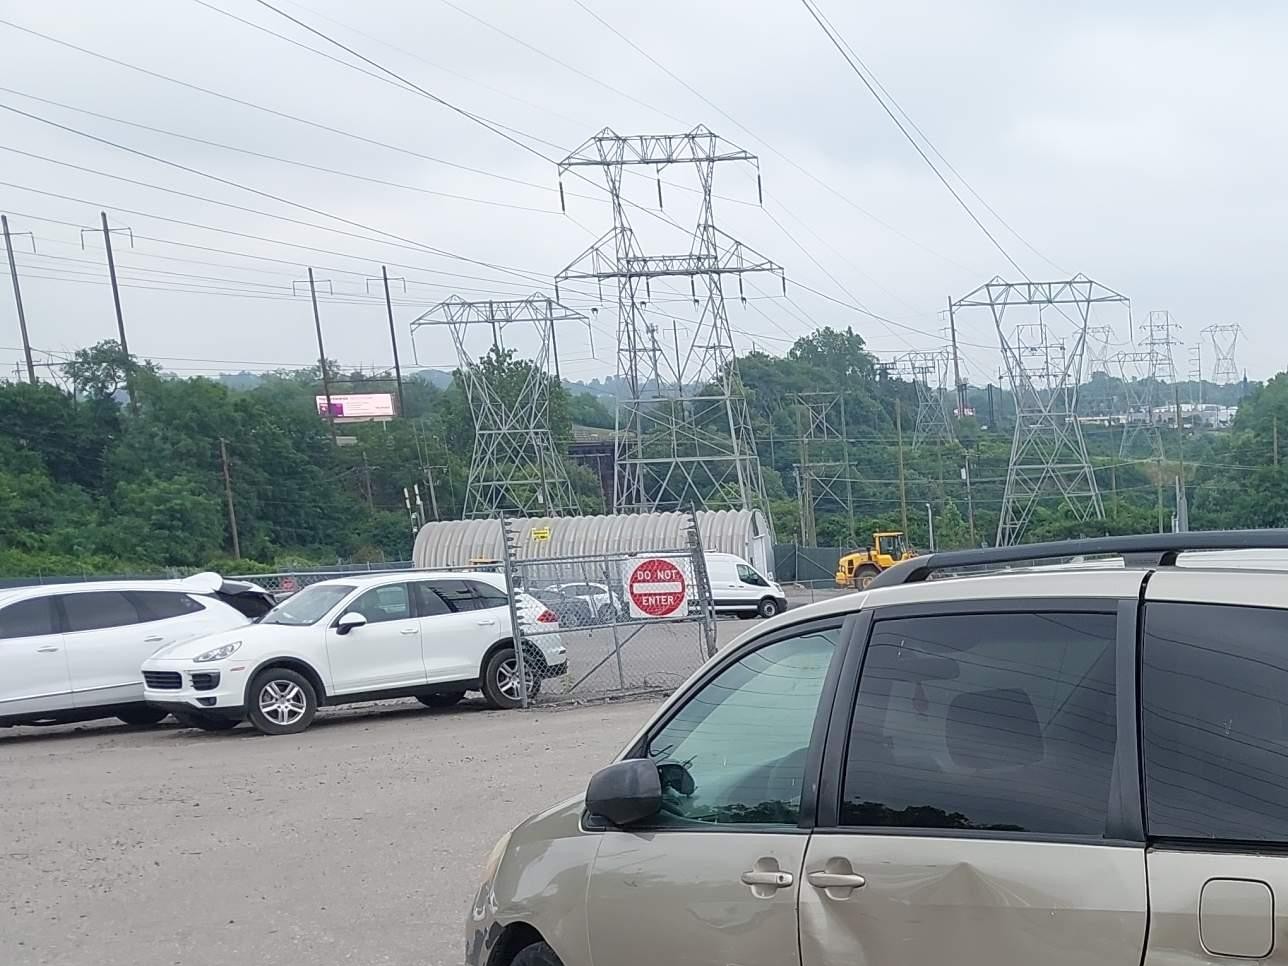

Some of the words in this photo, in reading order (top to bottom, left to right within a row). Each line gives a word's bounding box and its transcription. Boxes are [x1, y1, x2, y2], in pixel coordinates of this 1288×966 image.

[637, 571, 651, 580] DO
[657, 570, 678, 580] NOT
[642, 596, 674, 606] ENTER
